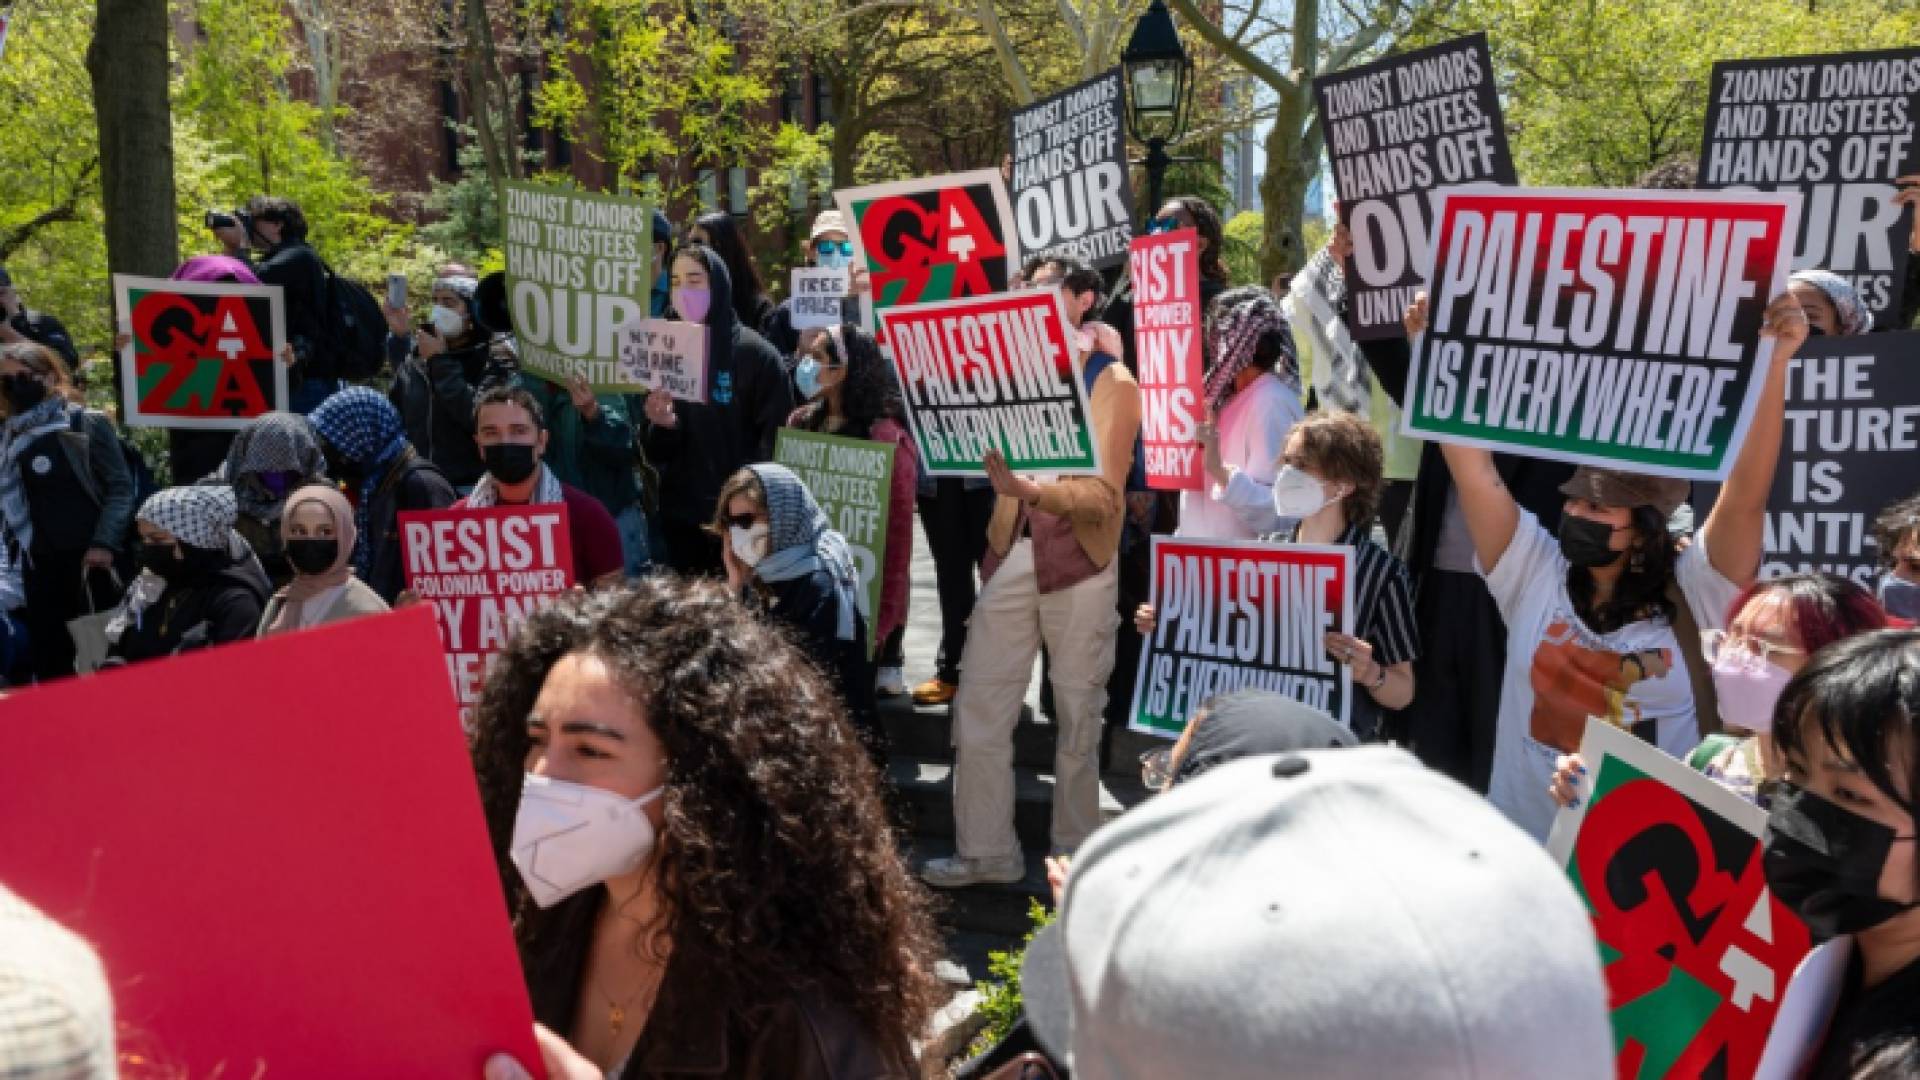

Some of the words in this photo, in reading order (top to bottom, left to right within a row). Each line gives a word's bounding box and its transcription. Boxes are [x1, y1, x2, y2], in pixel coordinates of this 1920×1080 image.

[1014, 100, 1061, 138] ZIONIST
[1065, 75, 1119, 121] DONORS
[1323, 70, 1393, 120] ZIONIST
[1396, 48, 1484, 104] DONORS
[1720, 67, 1815, 103] ZIONIST
[1820, 57, 1920, 97] DONORS
[1015, 133, 1043, 162] AND
[1046, 103, 1118, 150] TRUSTEES,
[1333, 116, 1370, 155] AND
[1372, 90, 1491, 146] TRUSTEES,
[1715, 105, 1767, 138] AND
[1776, 97, 1915, 137] TRUSTEES,
[1014, 142, 1077, 192] HANDS
[1082, 129, 1118, 166] OFF
[1336, 142, 1432, 200] HANDS
[1436, 127, 1496, 182] OFF
[1707, 137, 1831, 183] HANDS
[1840, 134, 1913, 180] OFF
[506, 188, 568, 222] ZIONIST
[572, 199, 643, 233] DONORS
[1018, 161, 1129, 249] OUR
[1790, 183, 1903, 271] UR
[507, 217, 540, 245] AND
[545, 223, 642, 261] TRUSTEES,
[509, 243, 586, 289] HANDS
[594, 259, 641, 294] OFF
[1131, 240, 1191, 306] SIST
[1434, 209, 1768, 362] PALESTINE
[512, 280, 641, 358] OUR
[893, 304, 1072, 405] PALESTINE
[1422, 339, 1464, 420] IS
[1463, 343, 1738, 457] EVERYWHERE
[1784, 405, 1920, 451] TURE
[828, 444, 887, 478] DONORS
[917, 409, 946, 461] IS
[939, 401, 1087, 462] EVERYWHERE
[1792, 461, 1844, 503] IS
[405, 514, 560, 573] RESIST
[840, 504, 881, 544] OFF
[412, 574, 493, 597] COLONIAL
[497, 570, 565, 594] POWER
[1156, 553, 1336, 675] PALESTINE
[1145, 653, 1173, 718] IS
